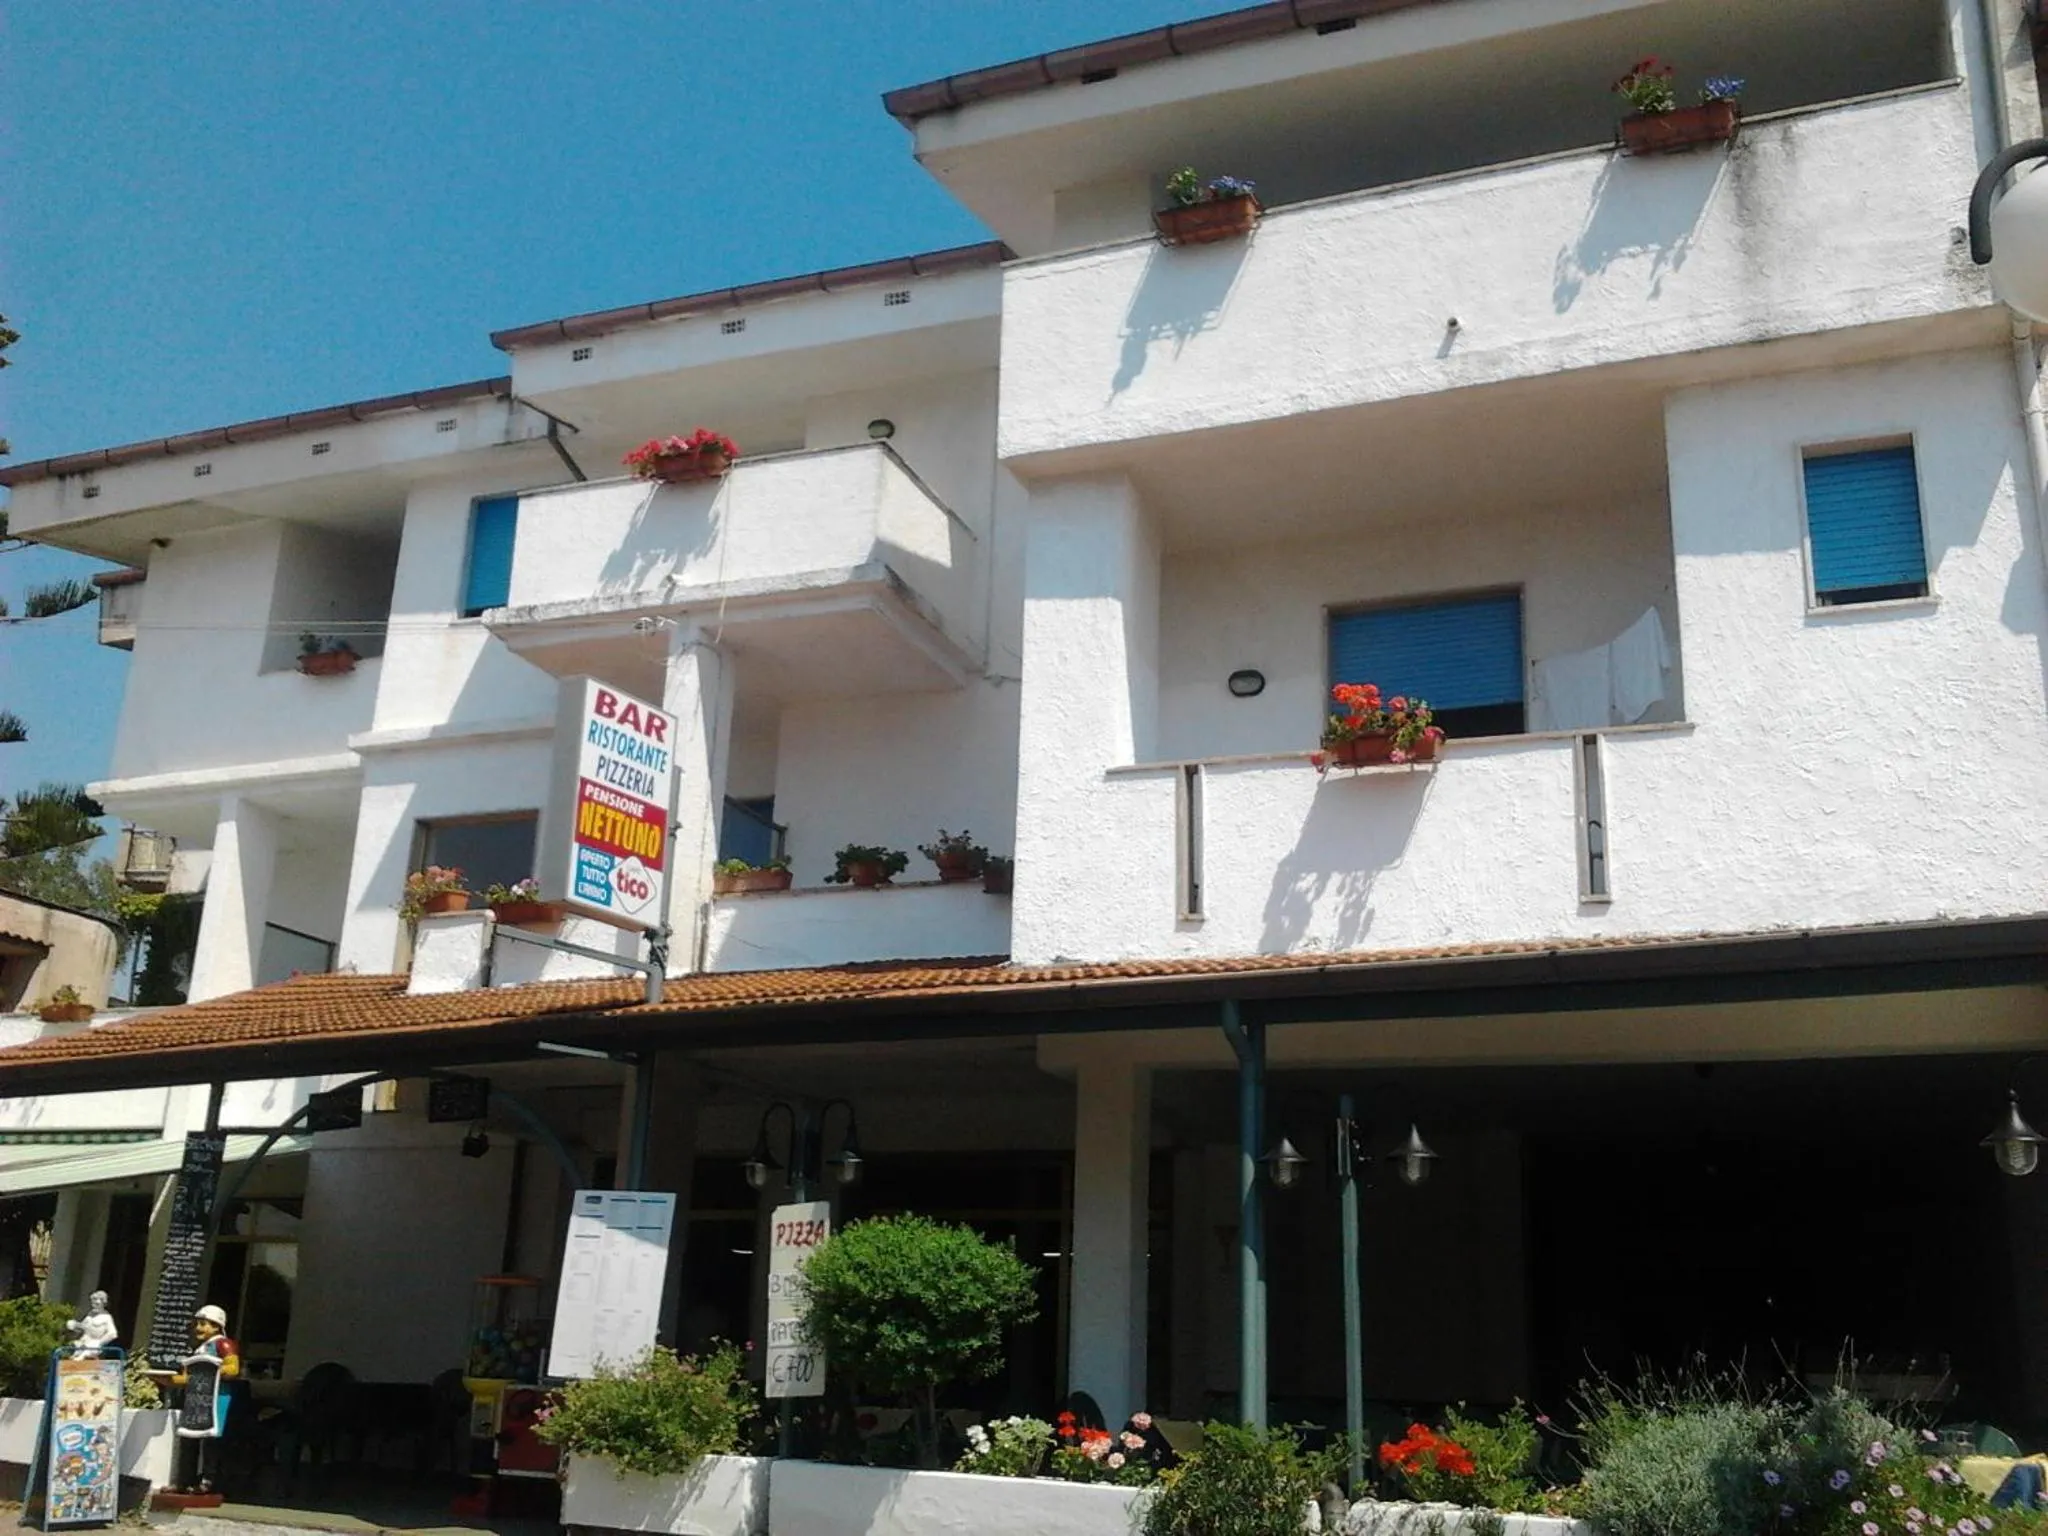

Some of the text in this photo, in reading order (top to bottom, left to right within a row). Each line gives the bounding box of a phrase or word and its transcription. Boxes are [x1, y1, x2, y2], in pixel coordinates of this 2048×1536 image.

[594, 687, 668, 744] BAR
[587, 719, 667, 774] RISTORANTE
[595, 755, 655, 798] PIZZERIA
[584, 784, 645, 817] PENSIONE
[579, 801, 662, 859] NETTUNO
[582, 864, 607, 885] TUTTO
[617, 868, 649, 900] tico
[776, 1219, 825, 1248] PIZZA
